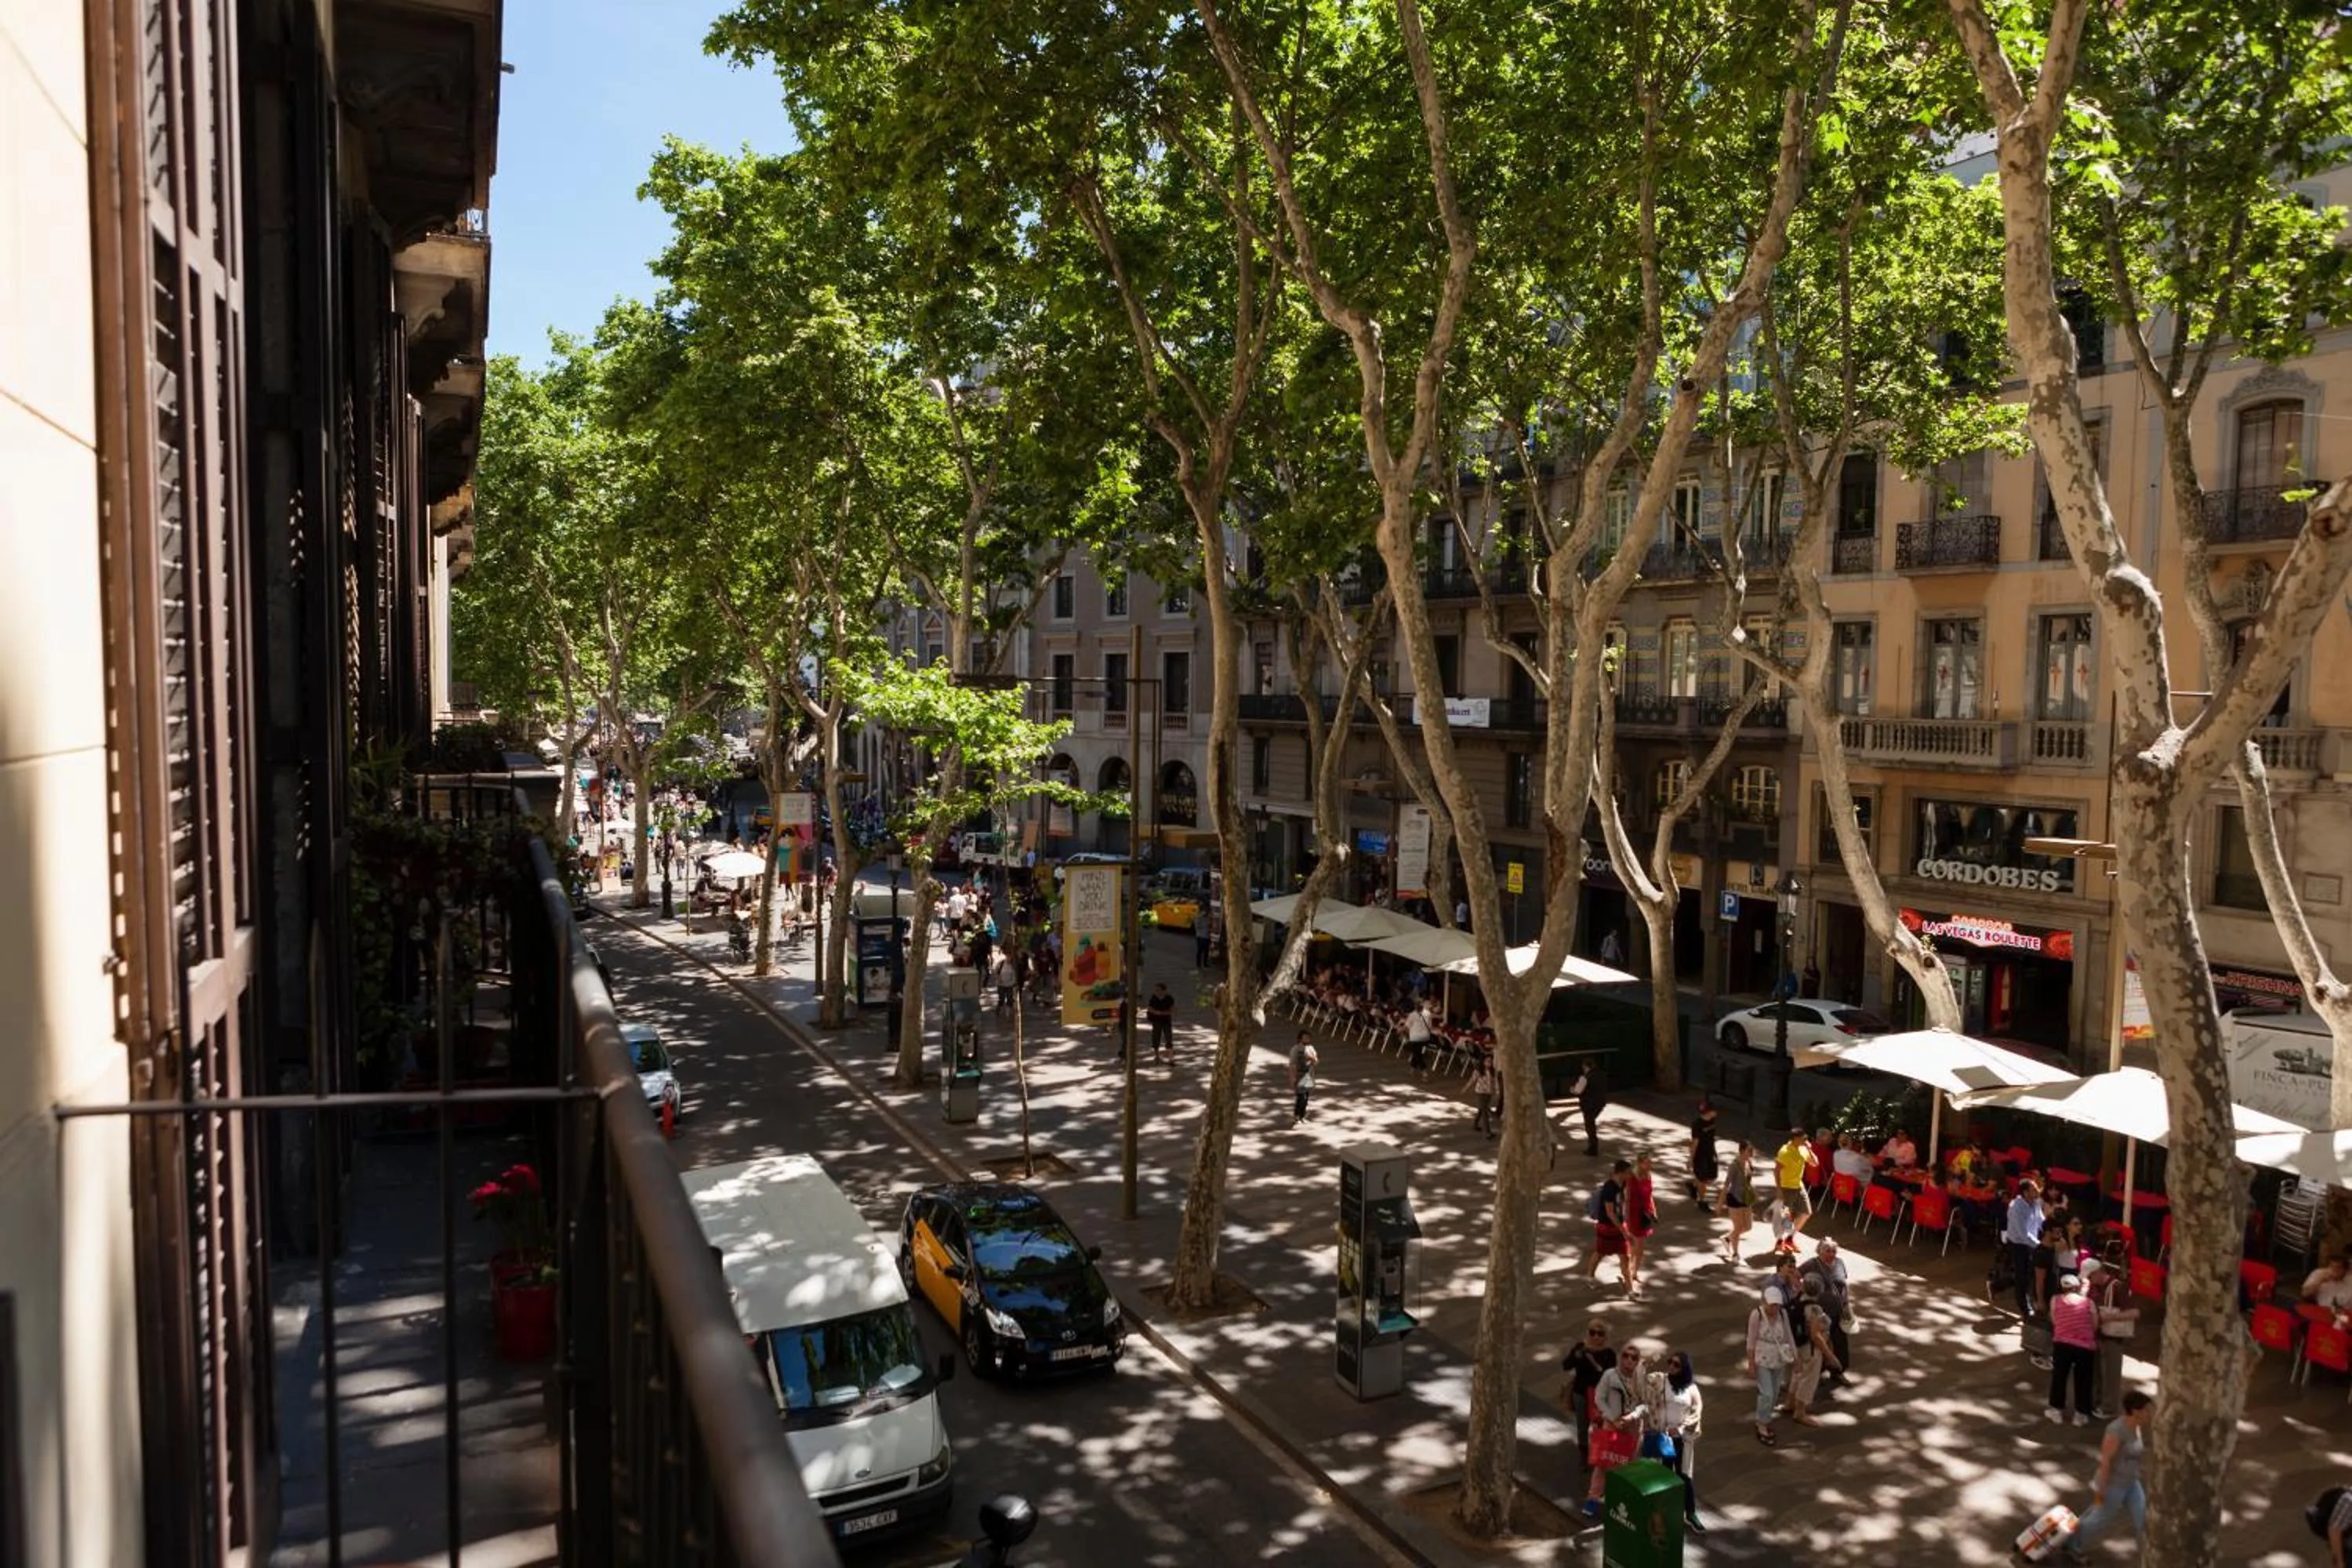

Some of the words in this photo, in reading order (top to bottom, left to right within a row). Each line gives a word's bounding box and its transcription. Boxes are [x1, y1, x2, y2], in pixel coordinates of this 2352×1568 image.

[1918, 858, 2060, 892] CORDOBES
[1725, 895, 1735, 912] P
[1922, 920, 1943, 935] LAS
[1945, 924, 1981, 941] VEGAS
[1984, 931, 2041, 951] ROULETTE
[2253, 1070, 2299, 1086] FINCA
